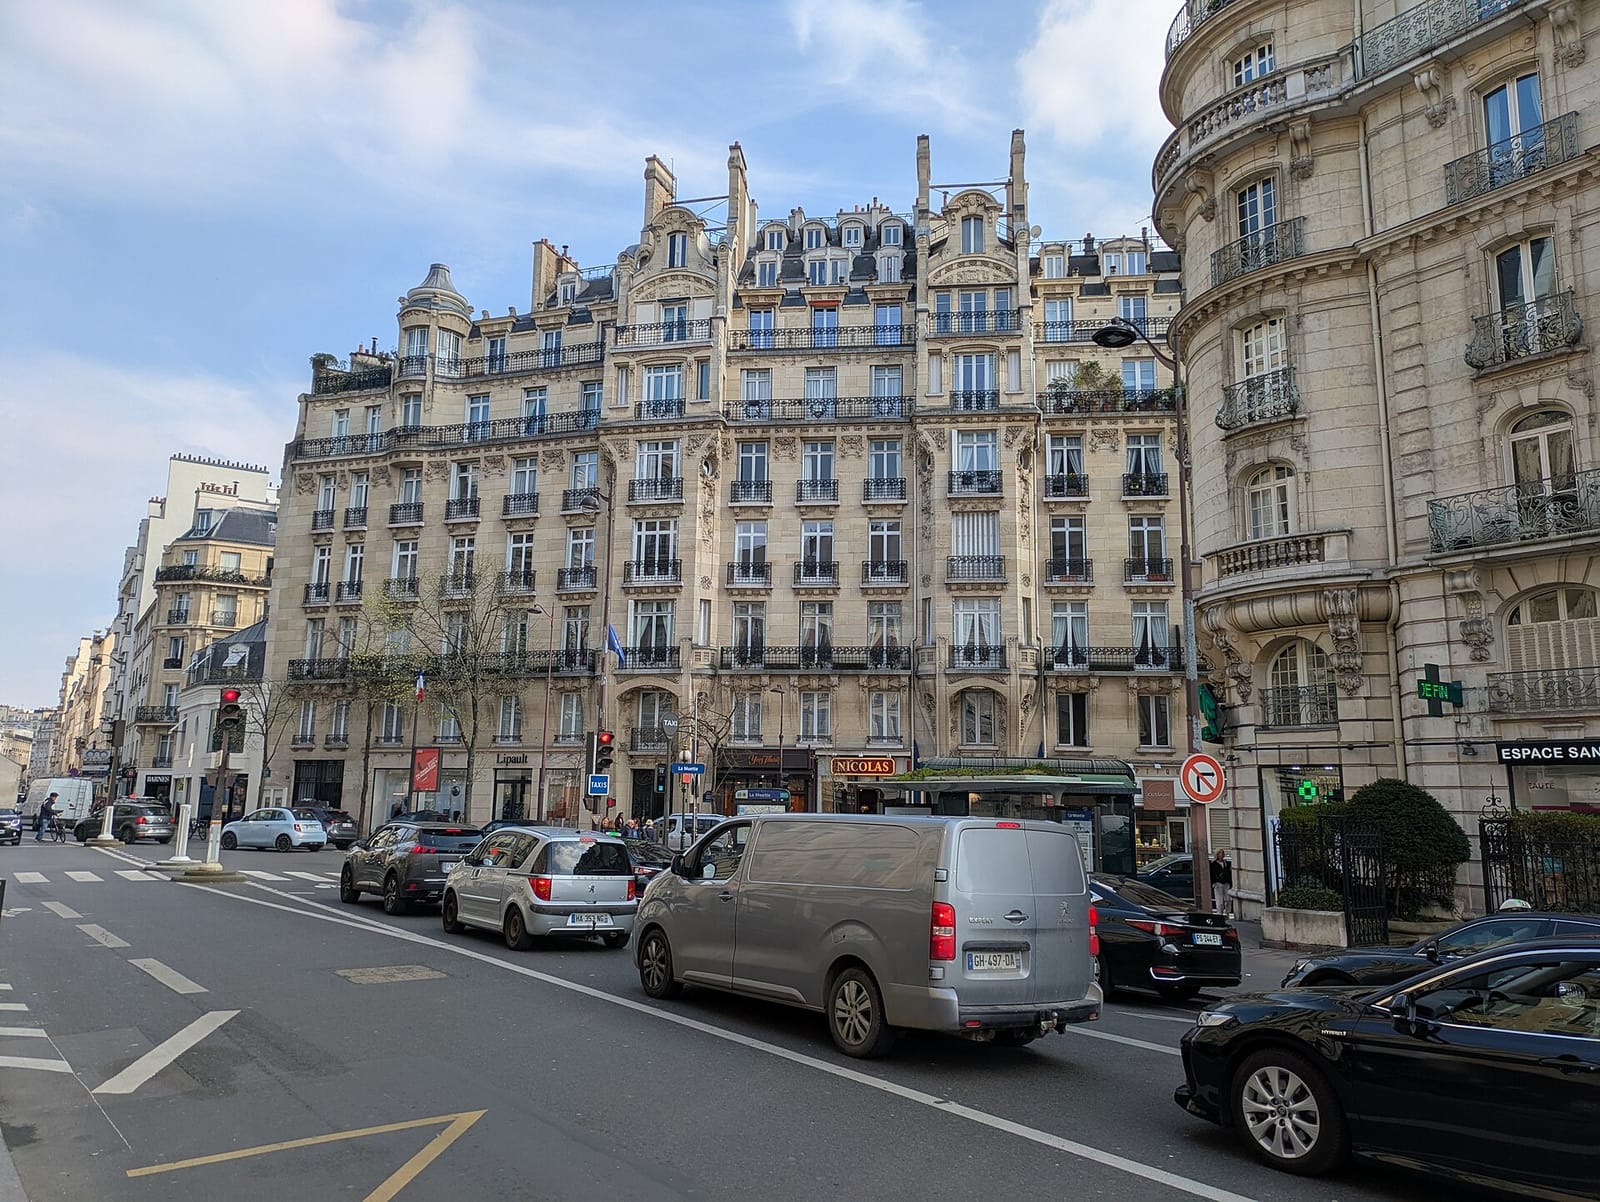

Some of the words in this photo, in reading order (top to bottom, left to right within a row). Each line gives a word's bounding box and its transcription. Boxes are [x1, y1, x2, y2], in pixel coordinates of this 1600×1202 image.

[663, 719, 678, 727] TAXI
[1501, 747, 1564, 760] ESPACE
[496, 753, 528, 766] Lipault
[837, 761, 889, 772] NICOLAS
[591, 781, 607, 789] TAXIS
